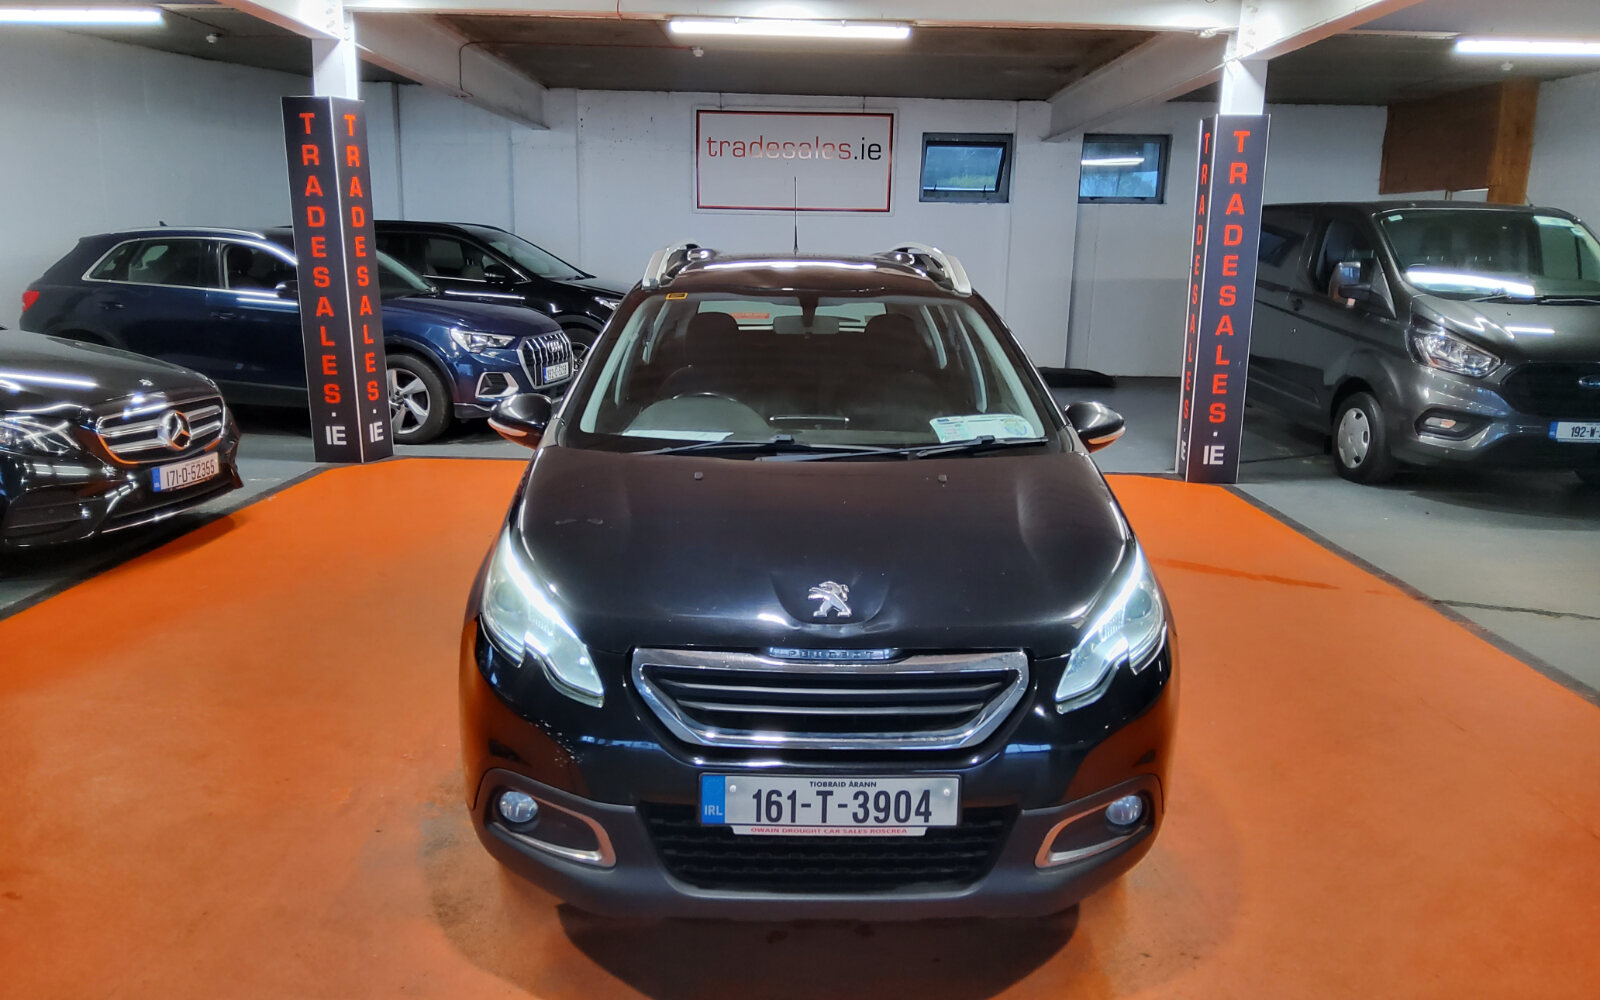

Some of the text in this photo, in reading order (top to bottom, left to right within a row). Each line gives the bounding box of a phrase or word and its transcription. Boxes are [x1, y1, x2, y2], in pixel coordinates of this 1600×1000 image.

[707, 135, 882, 161] tradesales.ie
[1571, 426, 1600, 438] 192-W-
[166, 459, 215, 487] 171-D-52355
[704, 804, 724, 816] IRL
[752, 789, 932, 824] 161-T-3904
